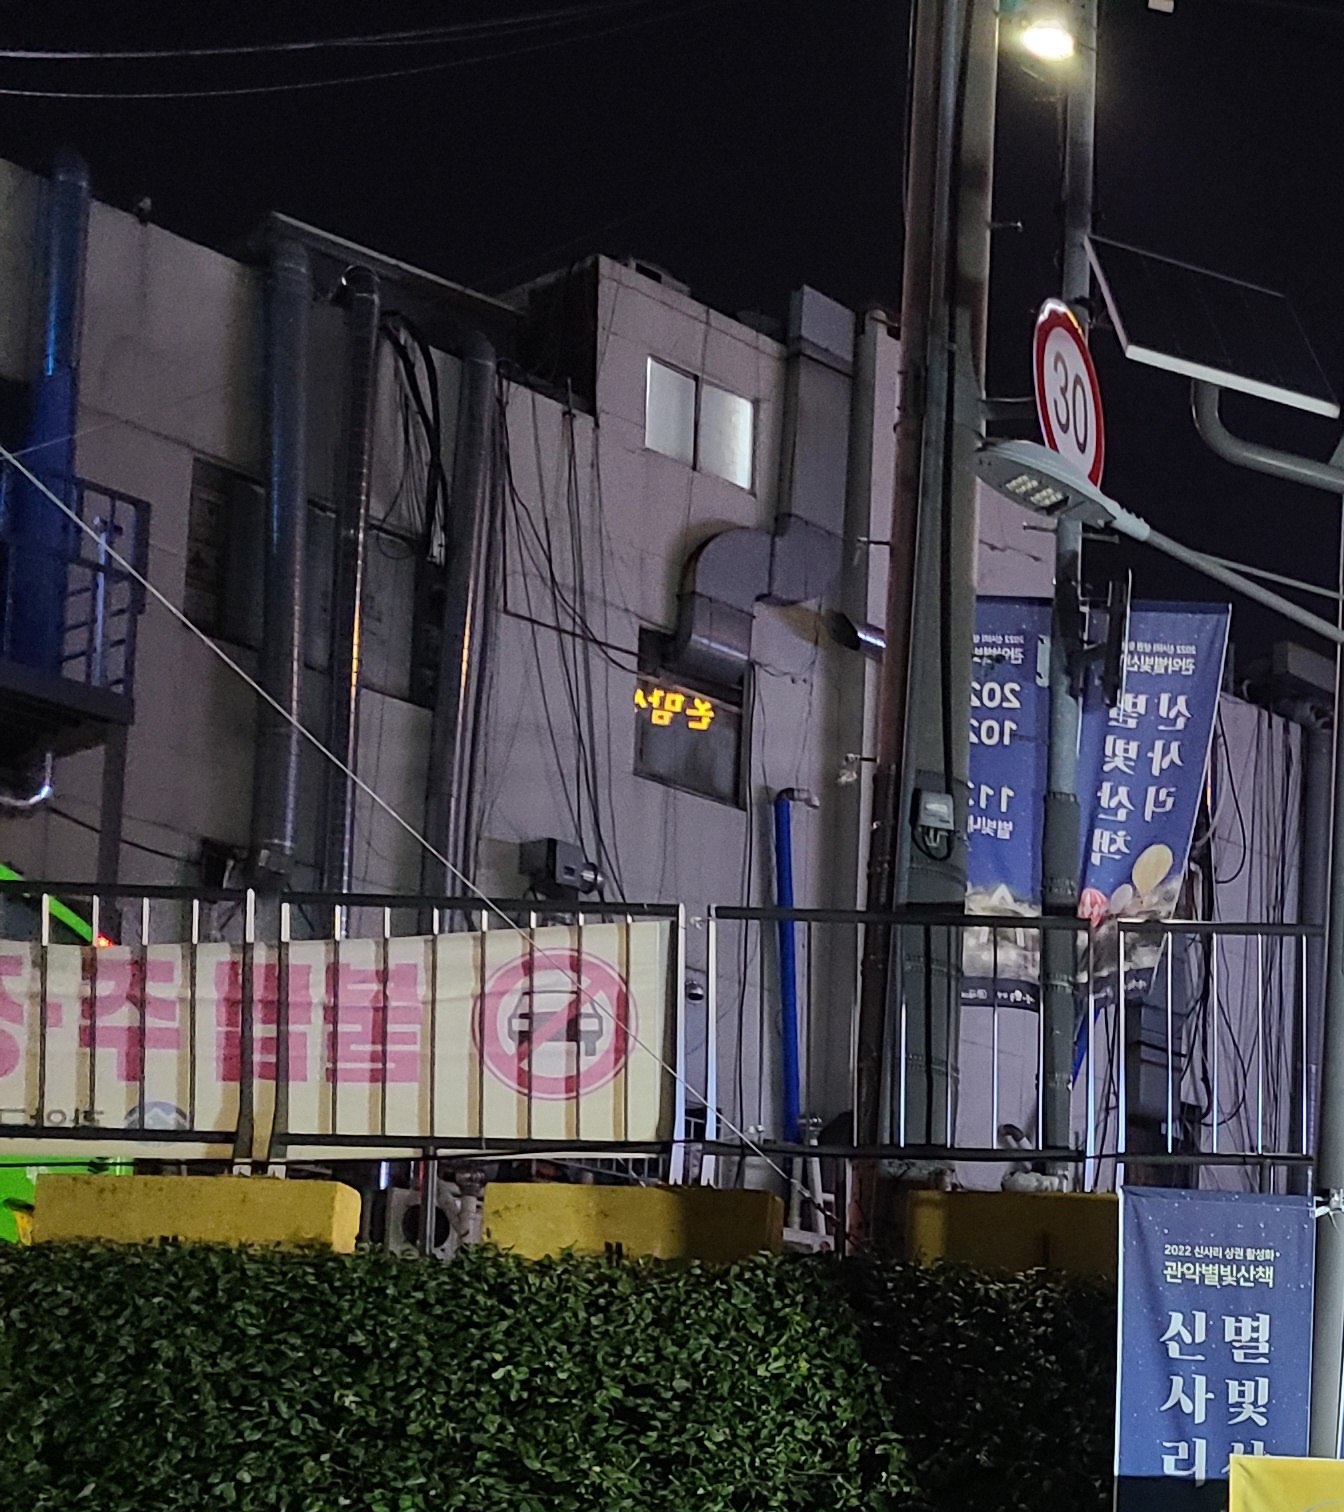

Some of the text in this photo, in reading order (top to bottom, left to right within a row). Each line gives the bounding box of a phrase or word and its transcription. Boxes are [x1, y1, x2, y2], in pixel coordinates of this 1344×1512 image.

[1053, 350, 1088, 455] 30
[1165, 1244, 1192, 1257] 2022
[1194, 1246, 1222, 1260] 신사리
[1225, 1246, 1244, 1260] 상권
[1163, 1261, 1275, 1288] 관악별빛산책
